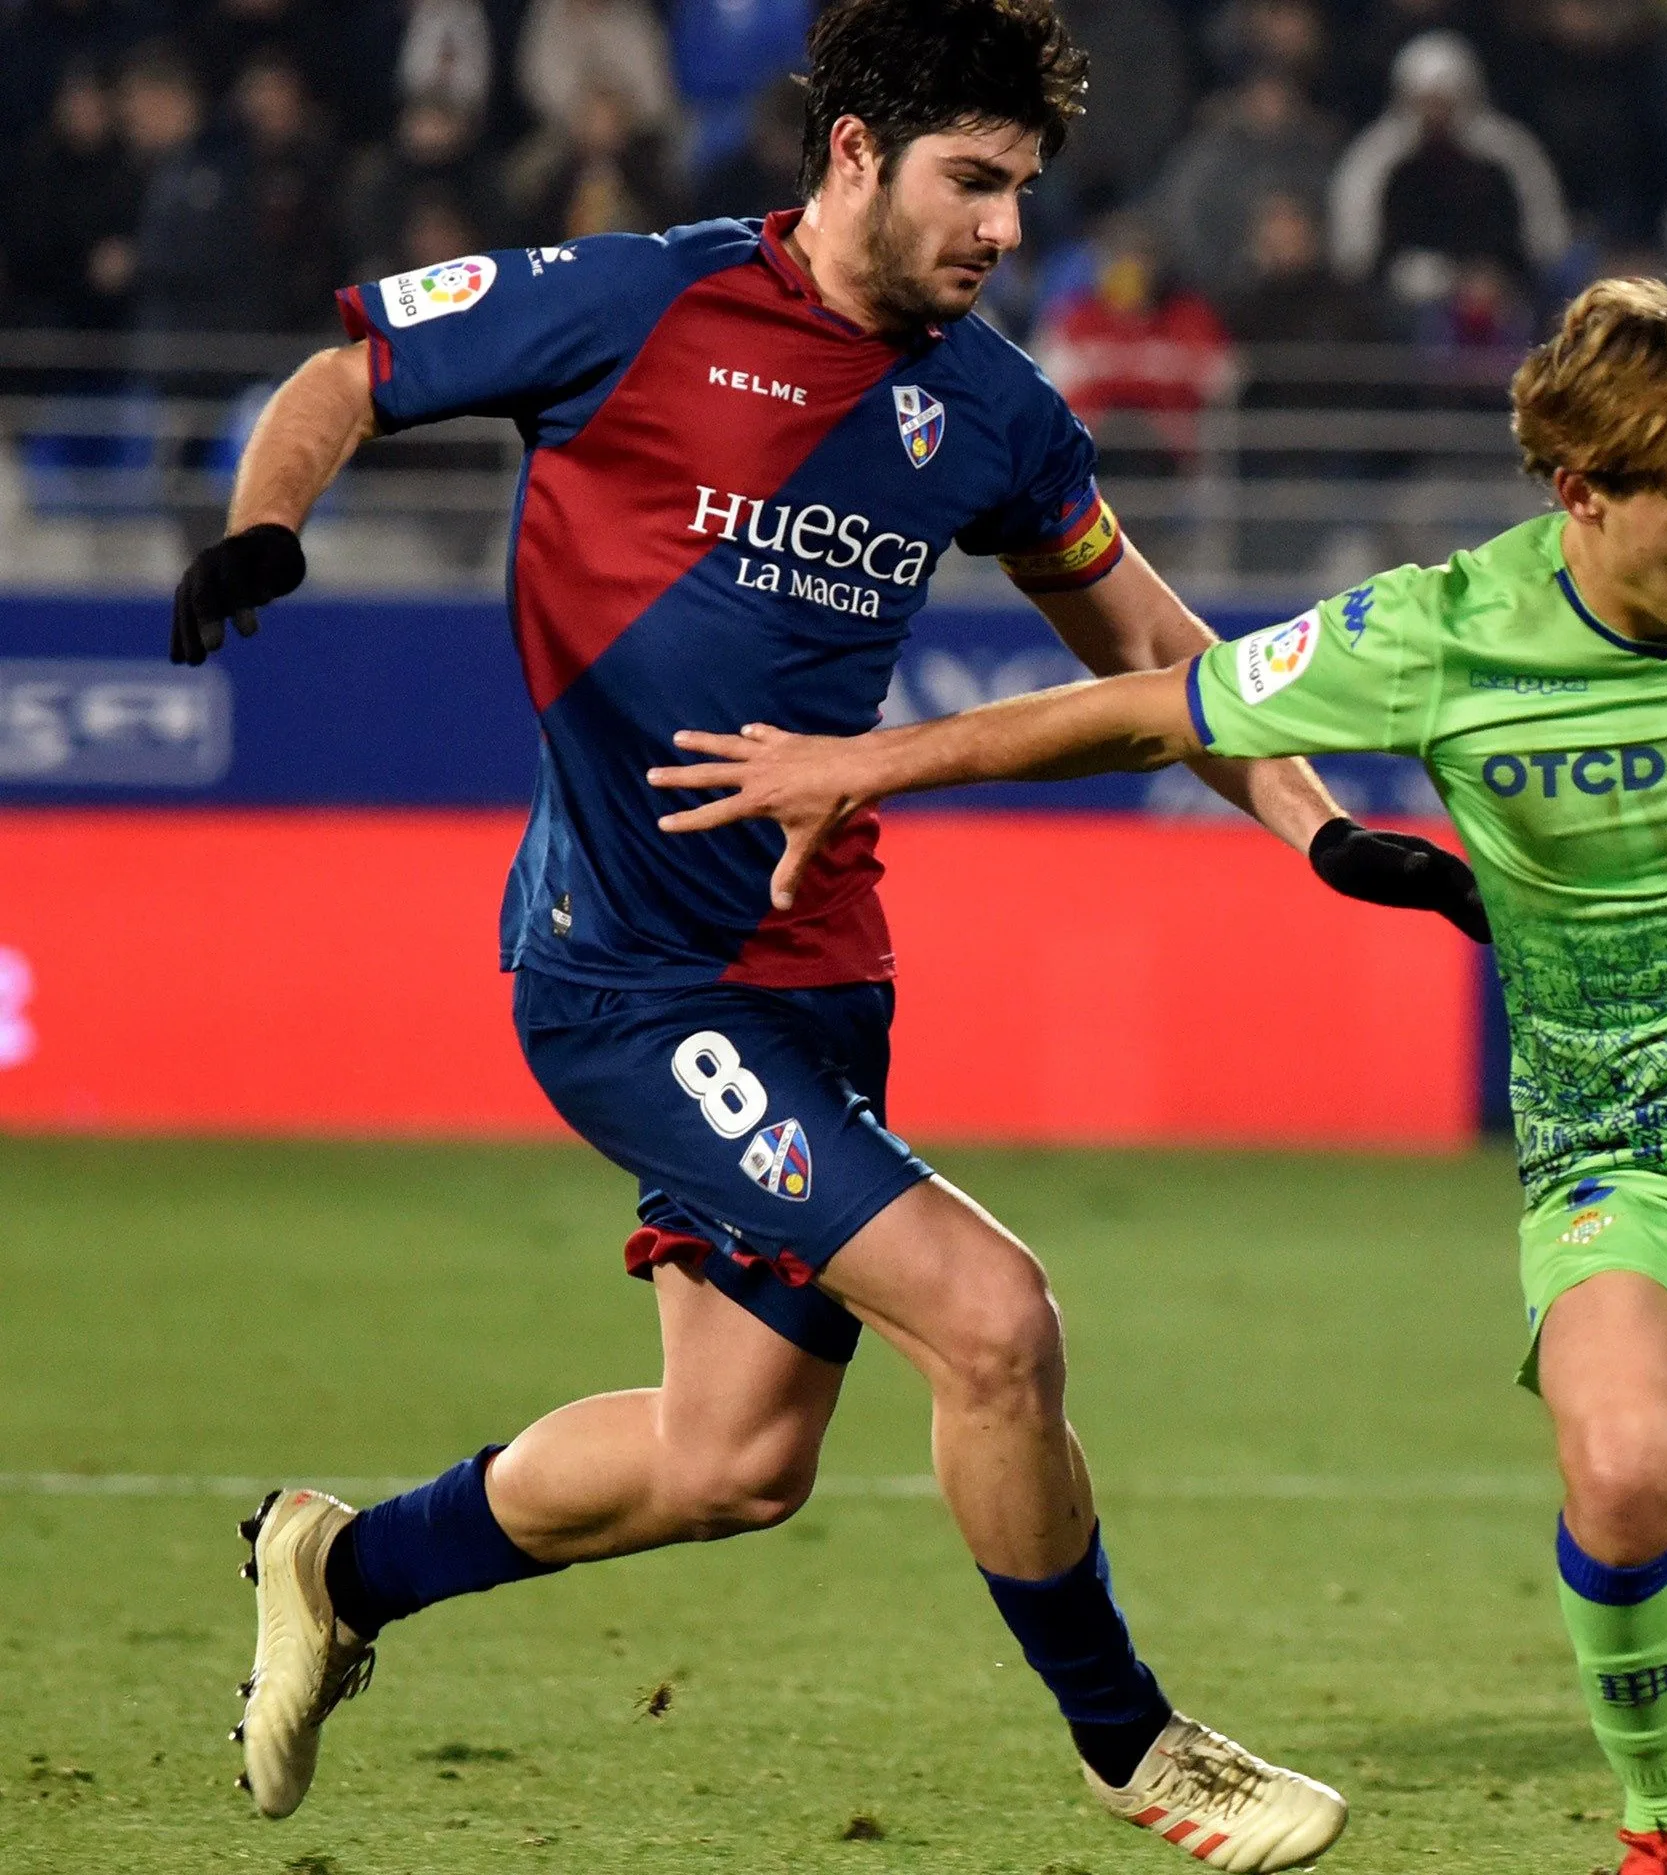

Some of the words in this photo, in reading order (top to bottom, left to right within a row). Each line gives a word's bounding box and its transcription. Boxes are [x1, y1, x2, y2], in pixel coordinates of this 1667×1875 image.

[708, 366, 808, 407] KELME
[687, 484, 930, 588] Huesca
[671, 1030, 769, 1140] 8
